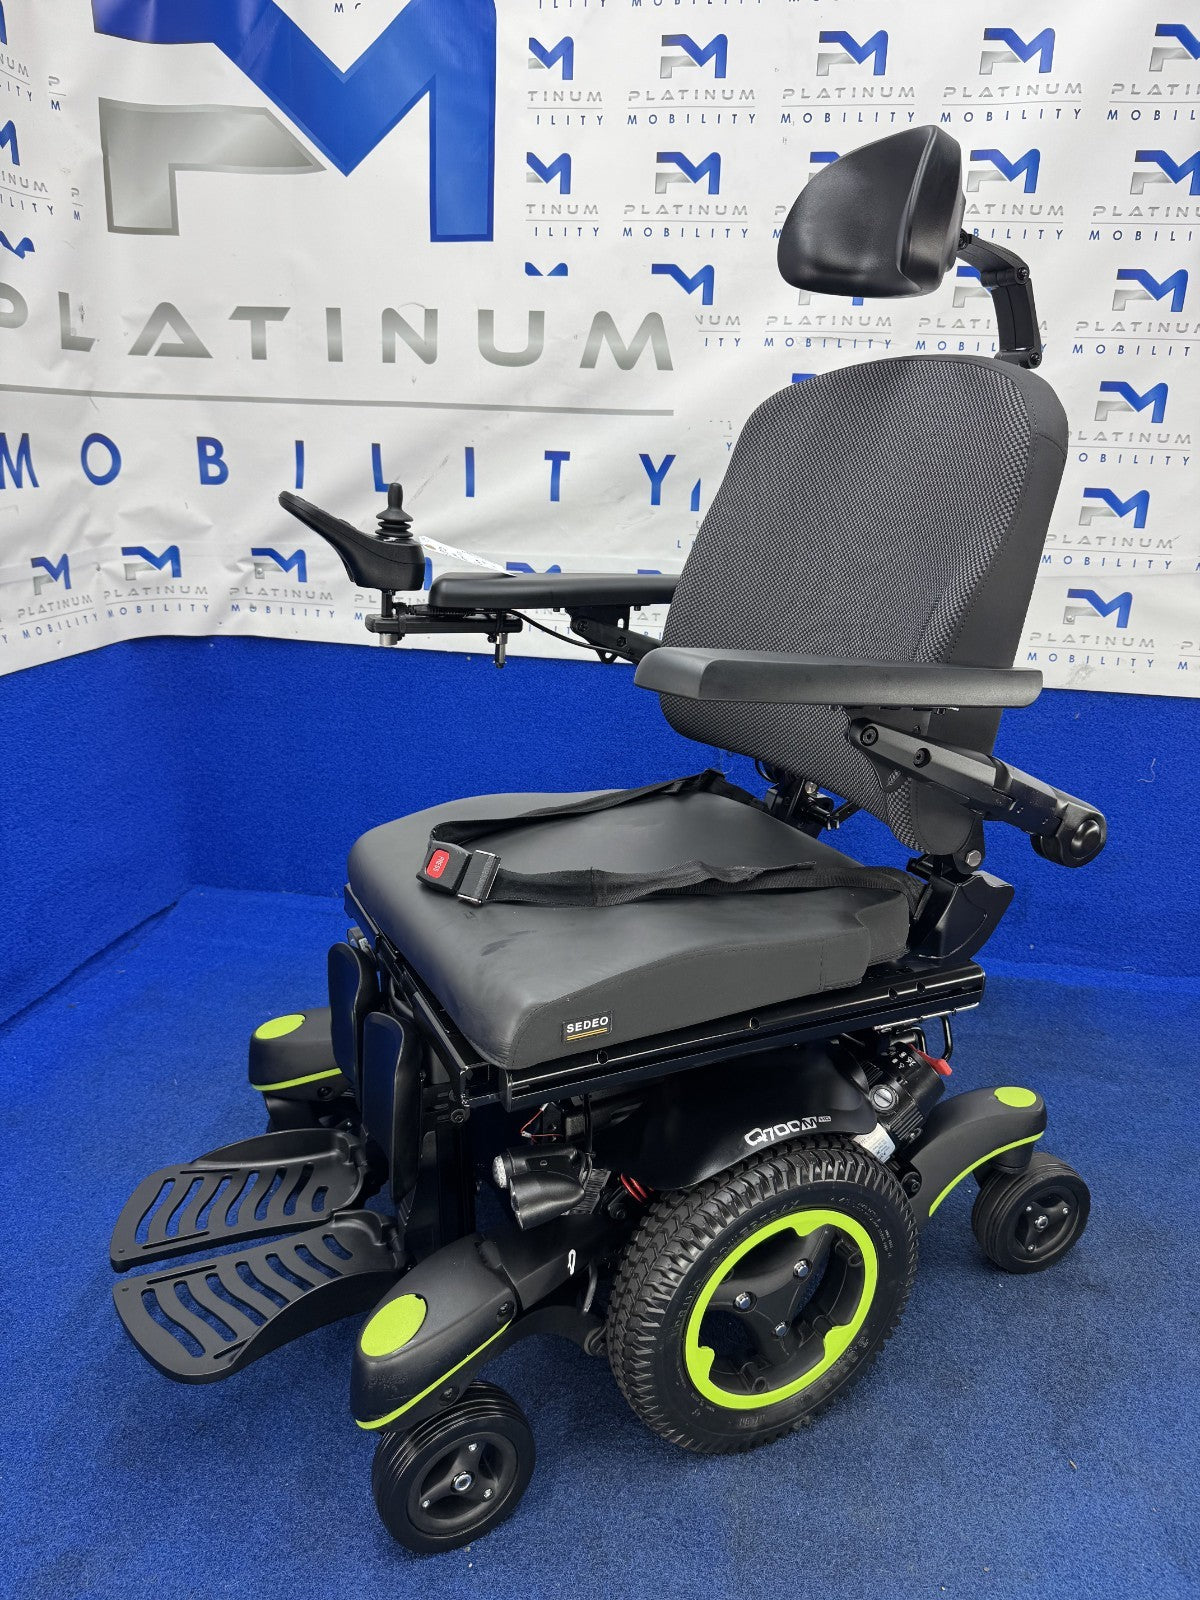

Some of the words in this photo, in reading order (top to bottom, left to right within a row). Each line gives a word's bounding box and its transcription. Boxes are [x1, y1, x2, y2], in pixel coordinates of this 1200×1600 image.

[528, 91, 602, 102] TINUM
[629, 89, 755, 101] PLATINUM
[783, 87, 915, 99] PLATINUM
[943, 83, 1082, 97] PLATINUM
[627, 114, 755, 124] MOBILITY
[781, 112, 914, 123] MOBILITY
[940, 109, 1081, 122] MOBILITY
[526, 204, 598, 214] TINUM
[624, 205, 747, 215] PLATINUM
[623, 227, 748, 238] MOBILITY
[767, 316, 892, 326] PLATINUM
[764, 337, 891, 349] MOBILITY
[1040, 555, 1172, 569] MOBILITY
[104, 585, 207, 600] PLATINUM
[228, 586, 333, 601] PLATINUM
[18, 593, 93, 620] PLATINUM
[107, 603, 209, 618] MOBILITY
[21, 612, 97, 639] MOBILITY
[1029, 632, 1154, 650] PLATINUM
[1025, 651, 1154, 669] MOBILITY
[567, 1016, 609, 1033] SEDEO
